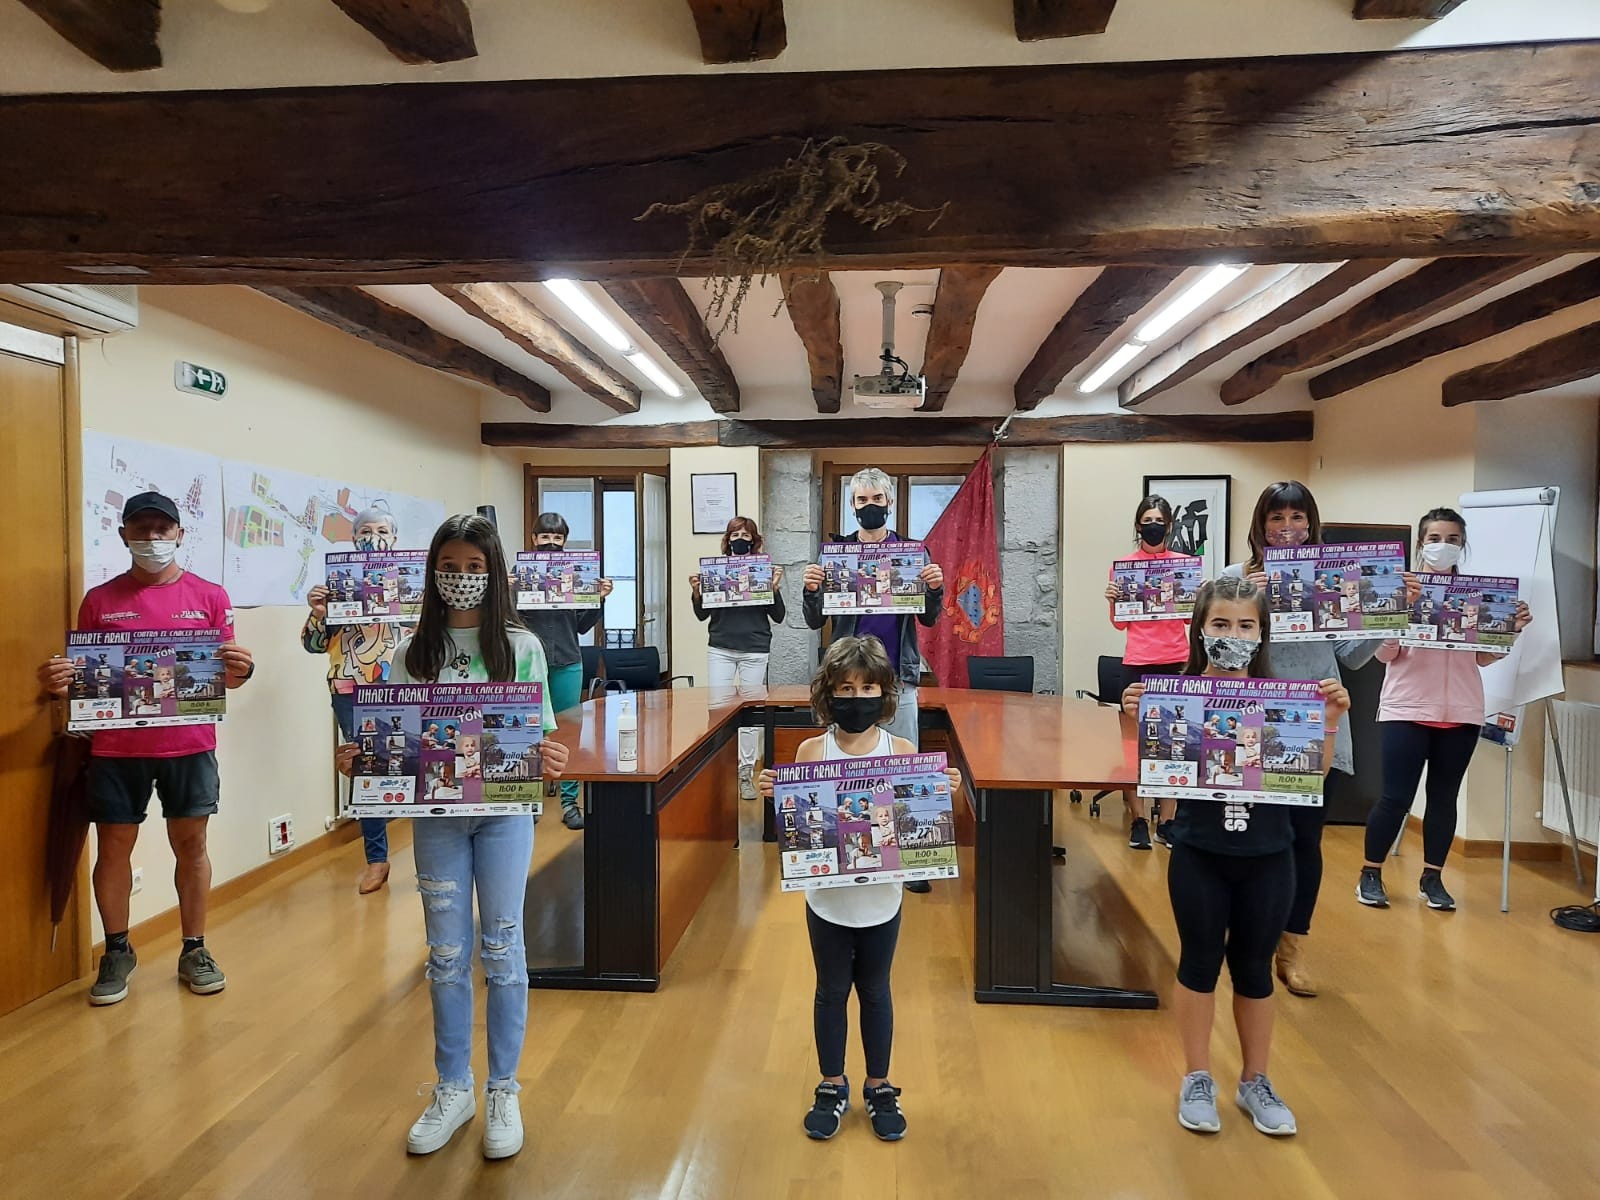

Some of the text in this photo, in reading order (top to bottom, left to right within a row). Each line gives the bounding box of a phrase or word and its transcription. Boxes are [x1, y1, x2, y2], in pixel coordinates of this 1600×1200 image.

[1266, 549, 1294, 560] UHARTE
[1297, 548, 1320, 559] ARAKIL
[1314, 560, 1354, 569] ZUMBA
[1342, 562, 1360, 572] TON
[70, 632, 131, 645] UHARTE ARAKIL
[124, 645, 170, 654] ZUMBA
[155, 648, 175, 658] TON
[433, 685, 538, 695] CONTRA EL CANCER INFANTIL
[1144, 679, 1213, 694] UHARTE ARAKIL
[1259, 682, 1287, 690] CANCER
[358, 687, 430, 703] UHARTE ARAKIL
[1204, 698, 1257, 709] ZUMBA
[422, 706, 474, 717] ZUMBA
[1240, 704, 1264, 716] TON
[458, 710, 482, 723] TON
[844, 761, 871, 770] CONTRA
[884, 758, 910, 766] CANCER
[913, 755, 942, 764] INFANTIL
[1284, 753, 1297, 764] 27
[504, 761, 517, 772] 27
[777, 764, 842, 782] UHARTE ARAKIL
[837, 778, 885, 791] ZUMBA
[870, 781, 893, 796] TON
[918, 827, 930, 839] 27
